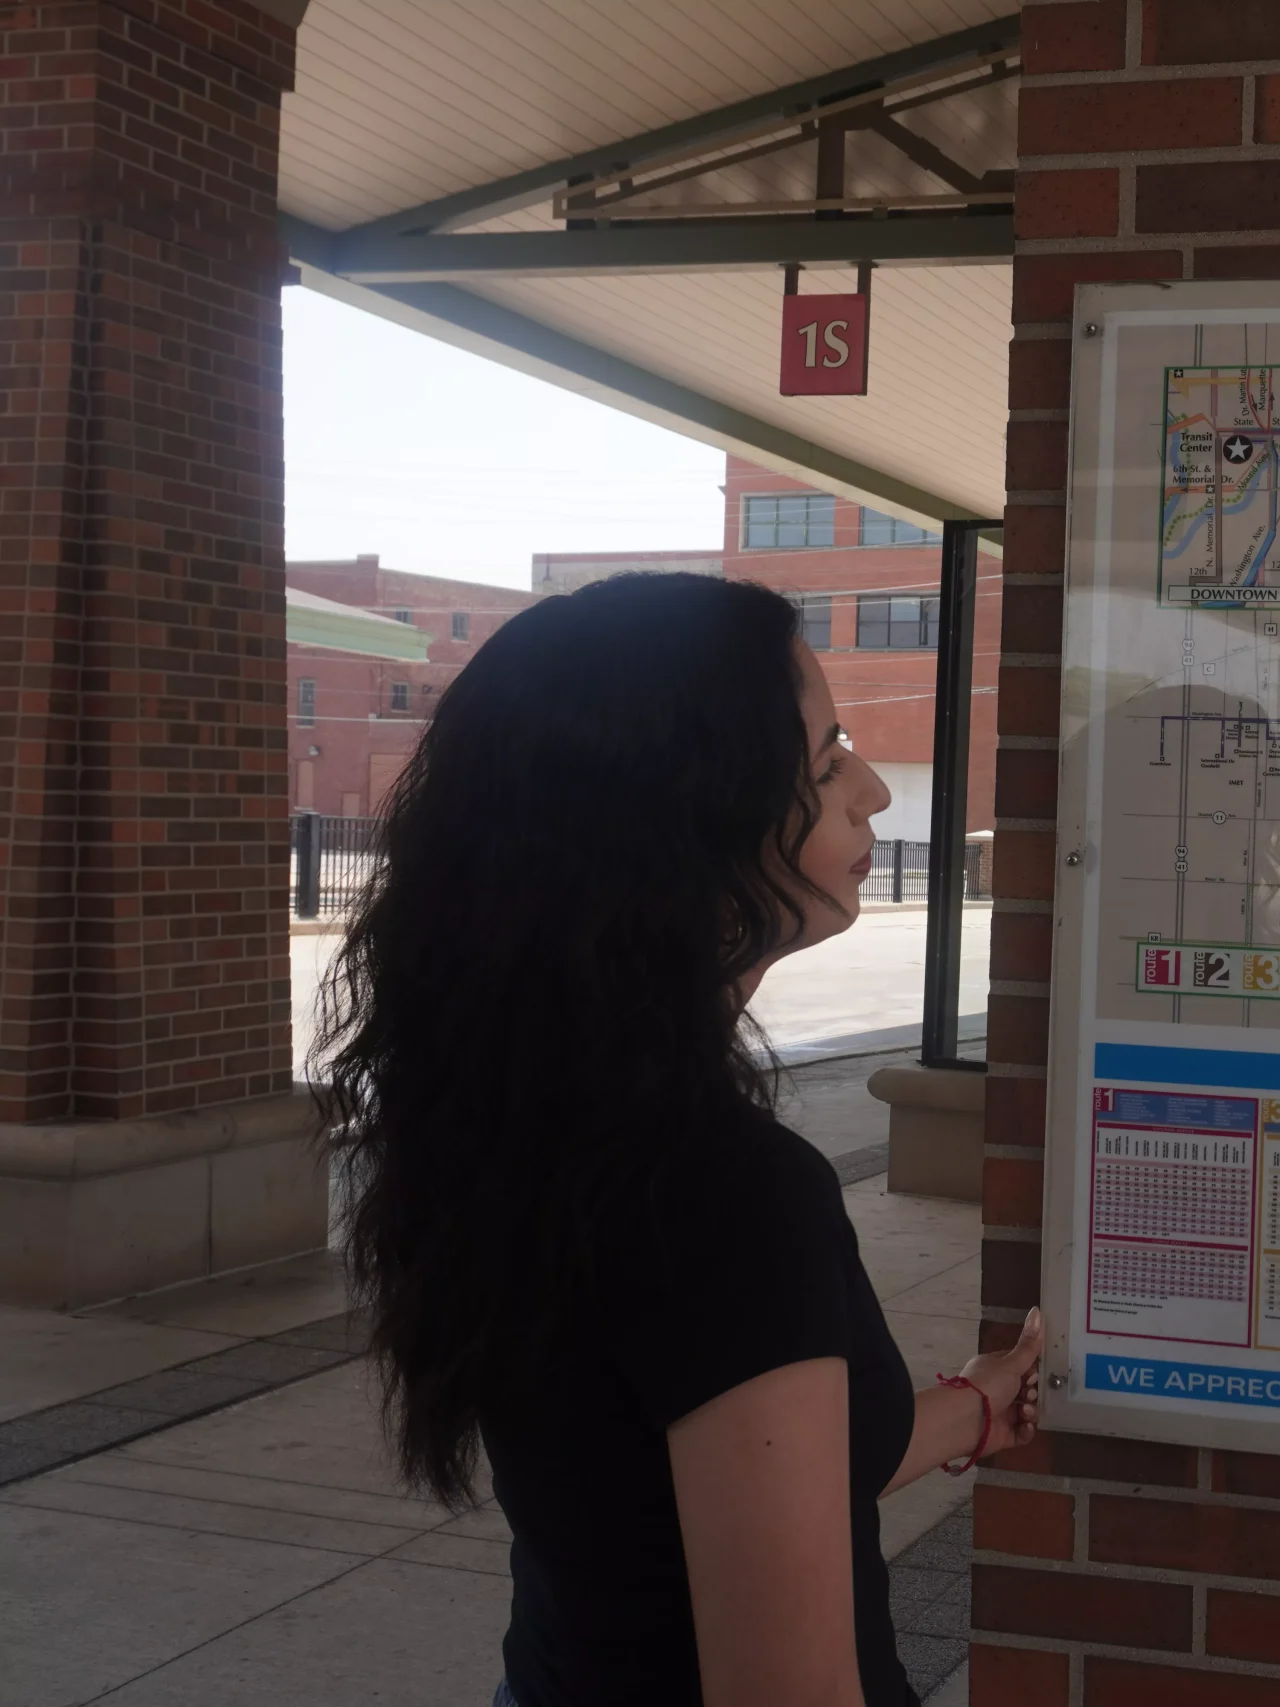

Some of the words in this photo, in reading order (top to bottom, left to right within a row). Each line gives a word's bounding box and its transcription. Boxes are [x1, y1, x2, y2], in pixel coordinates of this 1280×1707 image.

[798, 320, 849, 368] 1S
[1259, 369, 1267, 410] Marquette
[1180, 444, 1212, 452] Center
[1181, 432, 1212, 441] Transit
[1230, 546, 1255, 586] Washington
[1253, 526, 1265, 541] Ave.
[1191, 589, 1276, 599] DOWNTOWN
[1146, 949, 1156, 982] route
[1161, 950, 1176, 983] 1
[1195, 952, 1205, 985] route
[1208, 952, 1230, 986] 2
[1244, 954, 1254, 987] route
[1257, 955, 1280, 989] 3
[1104, 1089, 1114, 1111] 1
[1108, 1364, 1154, 1388] WE
